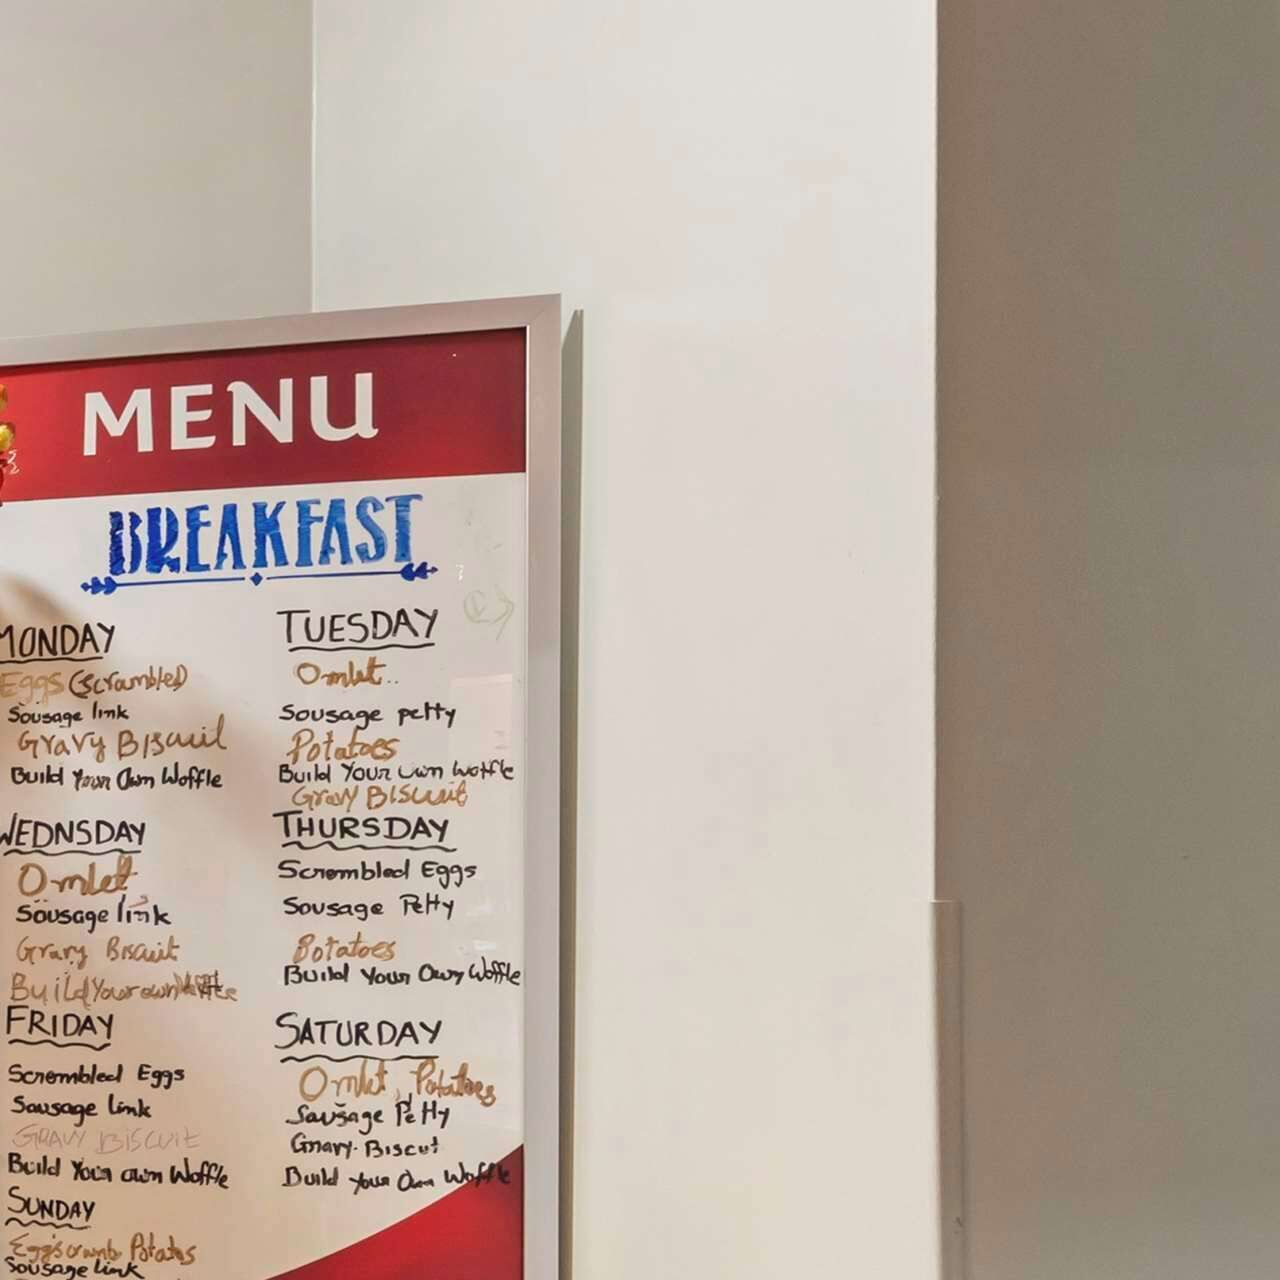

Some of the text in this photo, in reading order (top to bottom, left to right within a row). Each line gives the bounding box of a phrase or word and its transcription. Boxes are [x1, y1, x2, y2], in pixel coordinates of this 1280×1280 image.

[82, 372, 380, 457] MENU
[107, 493, 424, 576] BREAKFAST
[277, 608, 438, 643] TUESDAY
[0, 671, 65, 704] Eggs
[287, 729, 400, 765] Potatoes
[11, 765, 64, 786] Build
[279, 764, 331, 784] Build
[272, 810, 449, 842] THURSDAY
[421, 861, 478, 889] Eggs
[284, 963, 349, 985] Build
[7, 1005, 113, 1039] FRIDAY
[274, 1012, 442, 1049] SATURDAY
[137, 1064, 185, 1089] Eggs
[8, 1153, 61, 1177] Build
[282, 1166, 339, 1187] Build
[8, 1186, 95, 1222] SUNDAY
